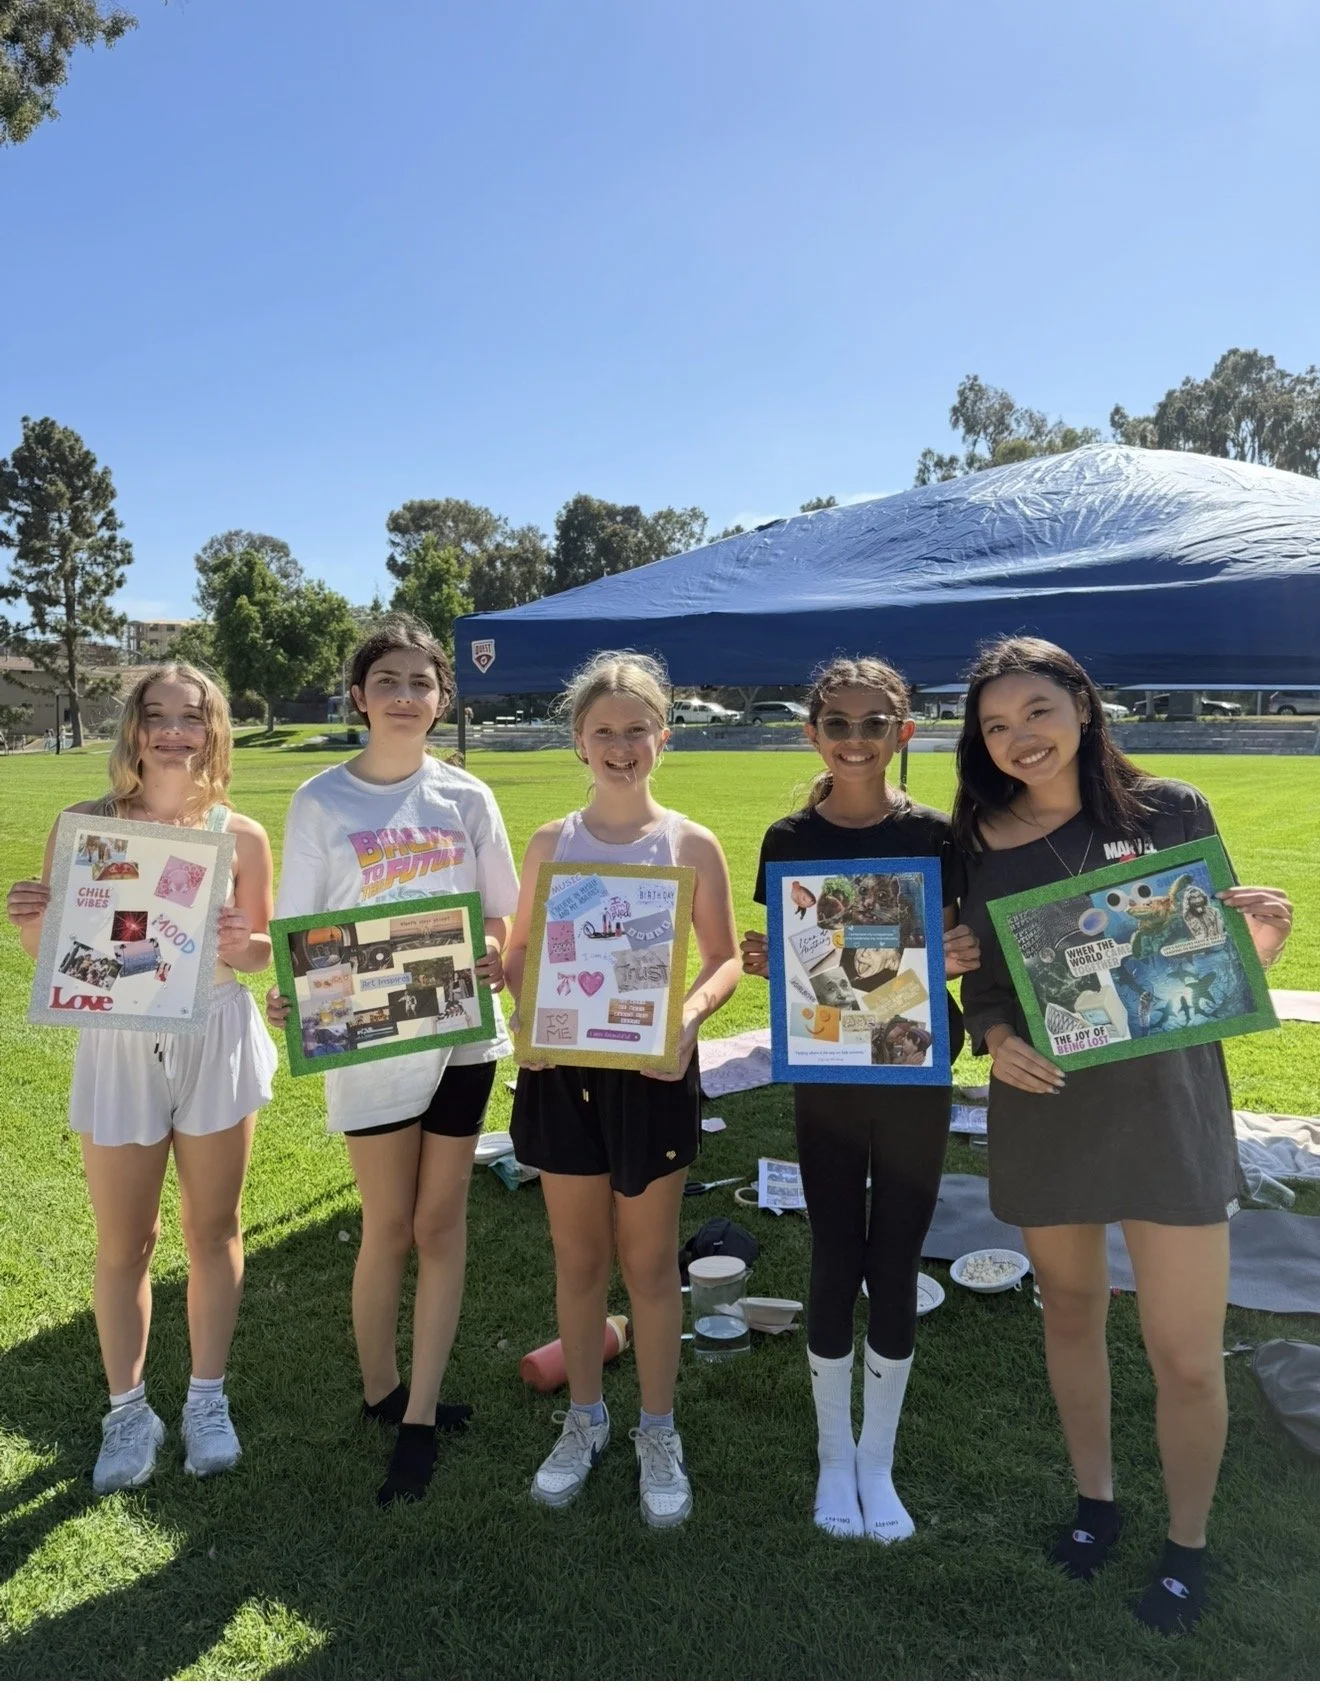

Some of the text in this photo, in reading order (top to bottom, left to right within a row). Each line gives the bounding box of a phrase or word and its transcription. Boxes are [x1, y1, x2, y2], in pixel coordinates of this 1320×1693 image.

[475, 643, 492, 655] QUEST
[1103, 838, 1158, 860] MARVEL
[361, 848, 467, 889] TO FUTURE
[552, 873, 582, 893] MUSIC
[572, 890, 580, 899] IN
[639, 890, 675, 900] BIRTHDAY
[568, 902, 578, 911] MY
[151, 913, 195, 954] MOOD
[1066, 939, 1115, 959] WHEN THE
[1068, 945, 1132, 968] WORLD CAME
[1072, 957, 1121, 976] TOGETHER
[361, 980, 377, 991] Art
[378, 975, 410, 988] Inspires
[546, 1015, 556, 1028] I
[546, 1027, 572, 1042] ME
[1054, 1026, 1105, 1046] THE JOY OF
[1056, 1035, 1109, 1054] BEING LOST
[875, 1520, 899, 1528] DRI-FIT
